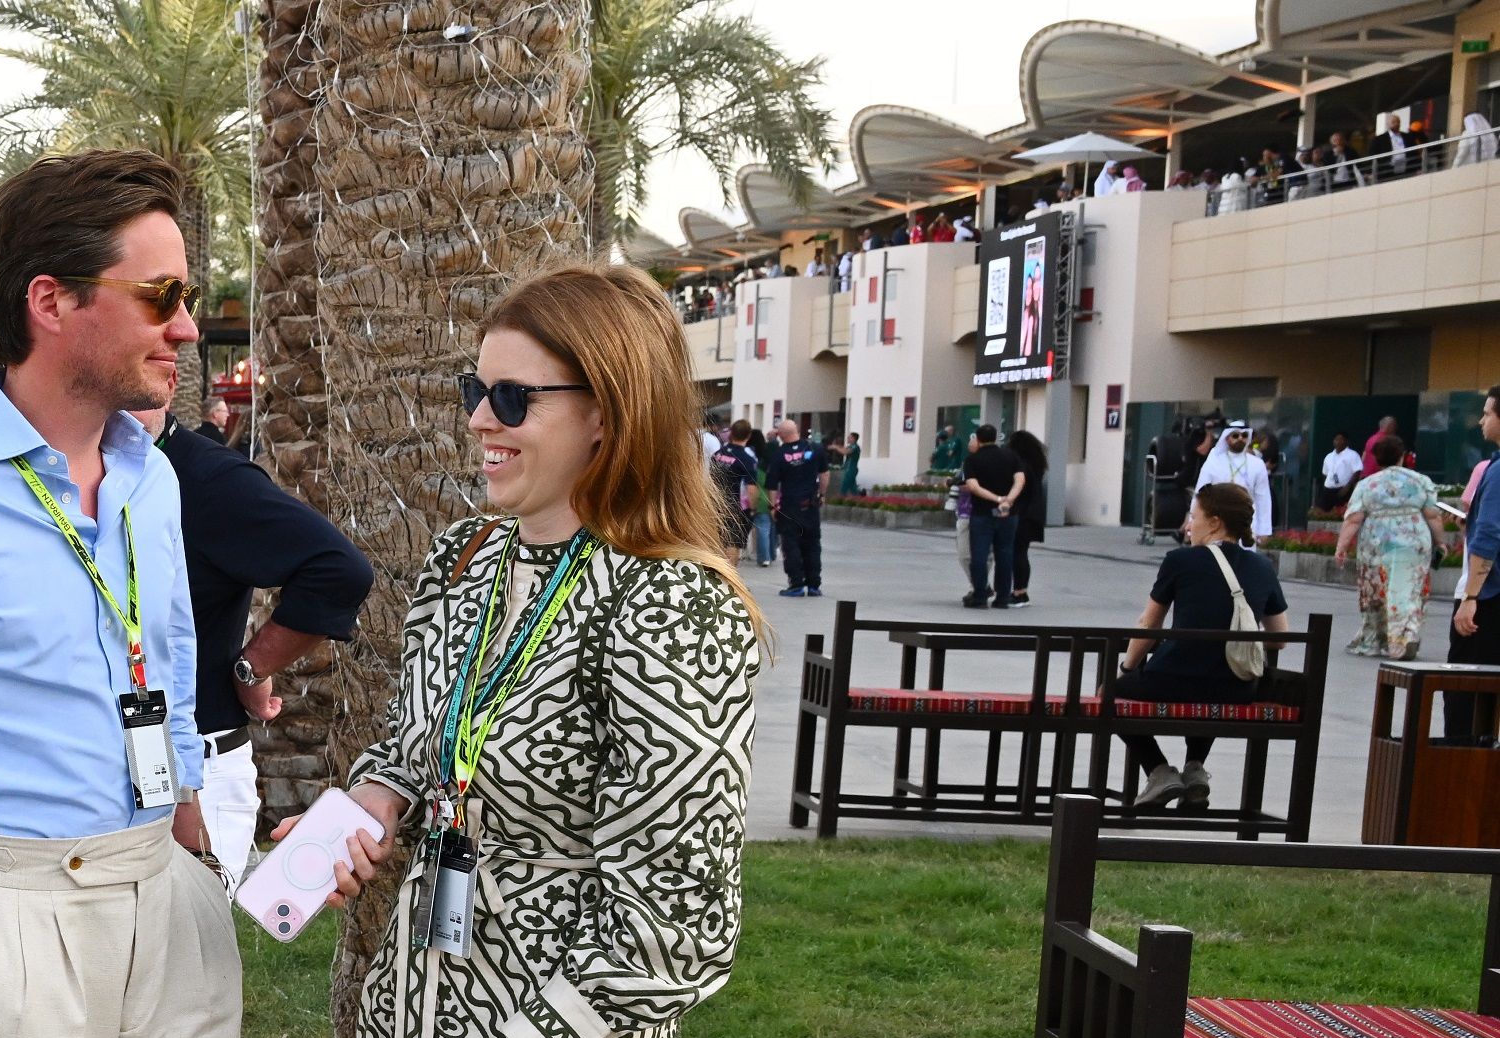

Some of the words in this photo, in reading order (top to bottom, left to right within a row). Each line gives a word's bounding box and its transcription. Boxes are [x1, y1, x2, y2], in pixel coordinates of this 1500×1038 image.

[1108, 412, 1118, 426] 17
[41, 493, 71, 531] BAHRAIN
[526, 611, 553, 654] BAHRAIN
